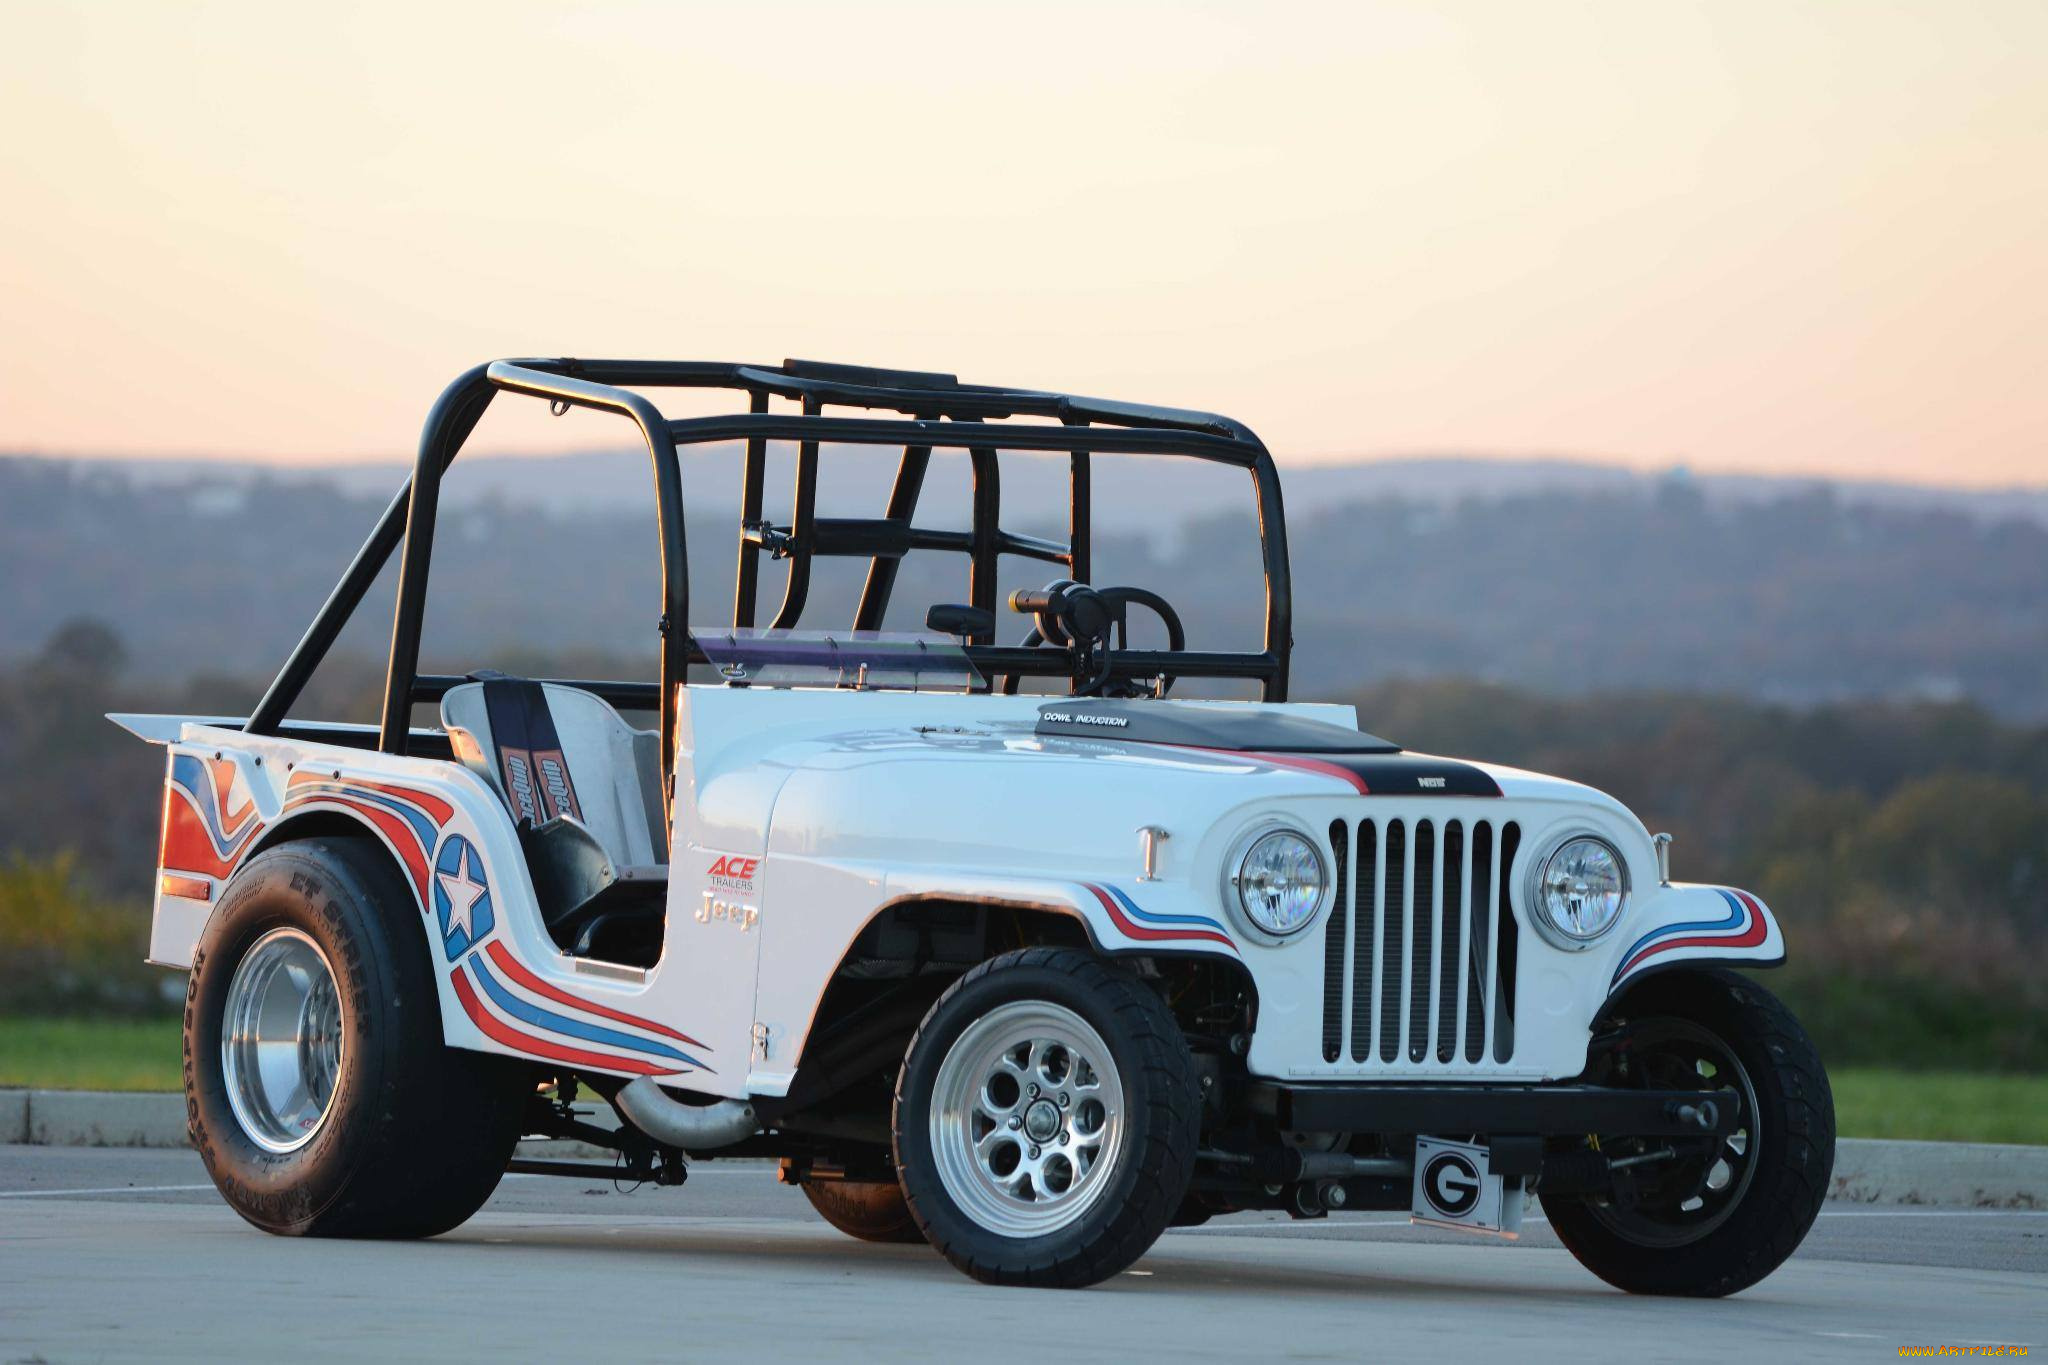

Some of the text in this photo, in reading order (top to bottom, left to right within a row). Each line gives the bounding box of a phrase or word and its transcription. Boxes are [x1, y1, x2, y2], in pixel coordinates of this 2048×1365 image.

[1044, 712, 1128, 726] COWL INDUCTION
[509, 756, 538, 830] aceQuip
[707, 856, 757, 879] ACE
[289, 872, 321, 898] ET
[712, 876, 753, 891] TRAILERS
[696, 891, 758, 931] Jeep
[1424, 1155, 1479, 1214] G
